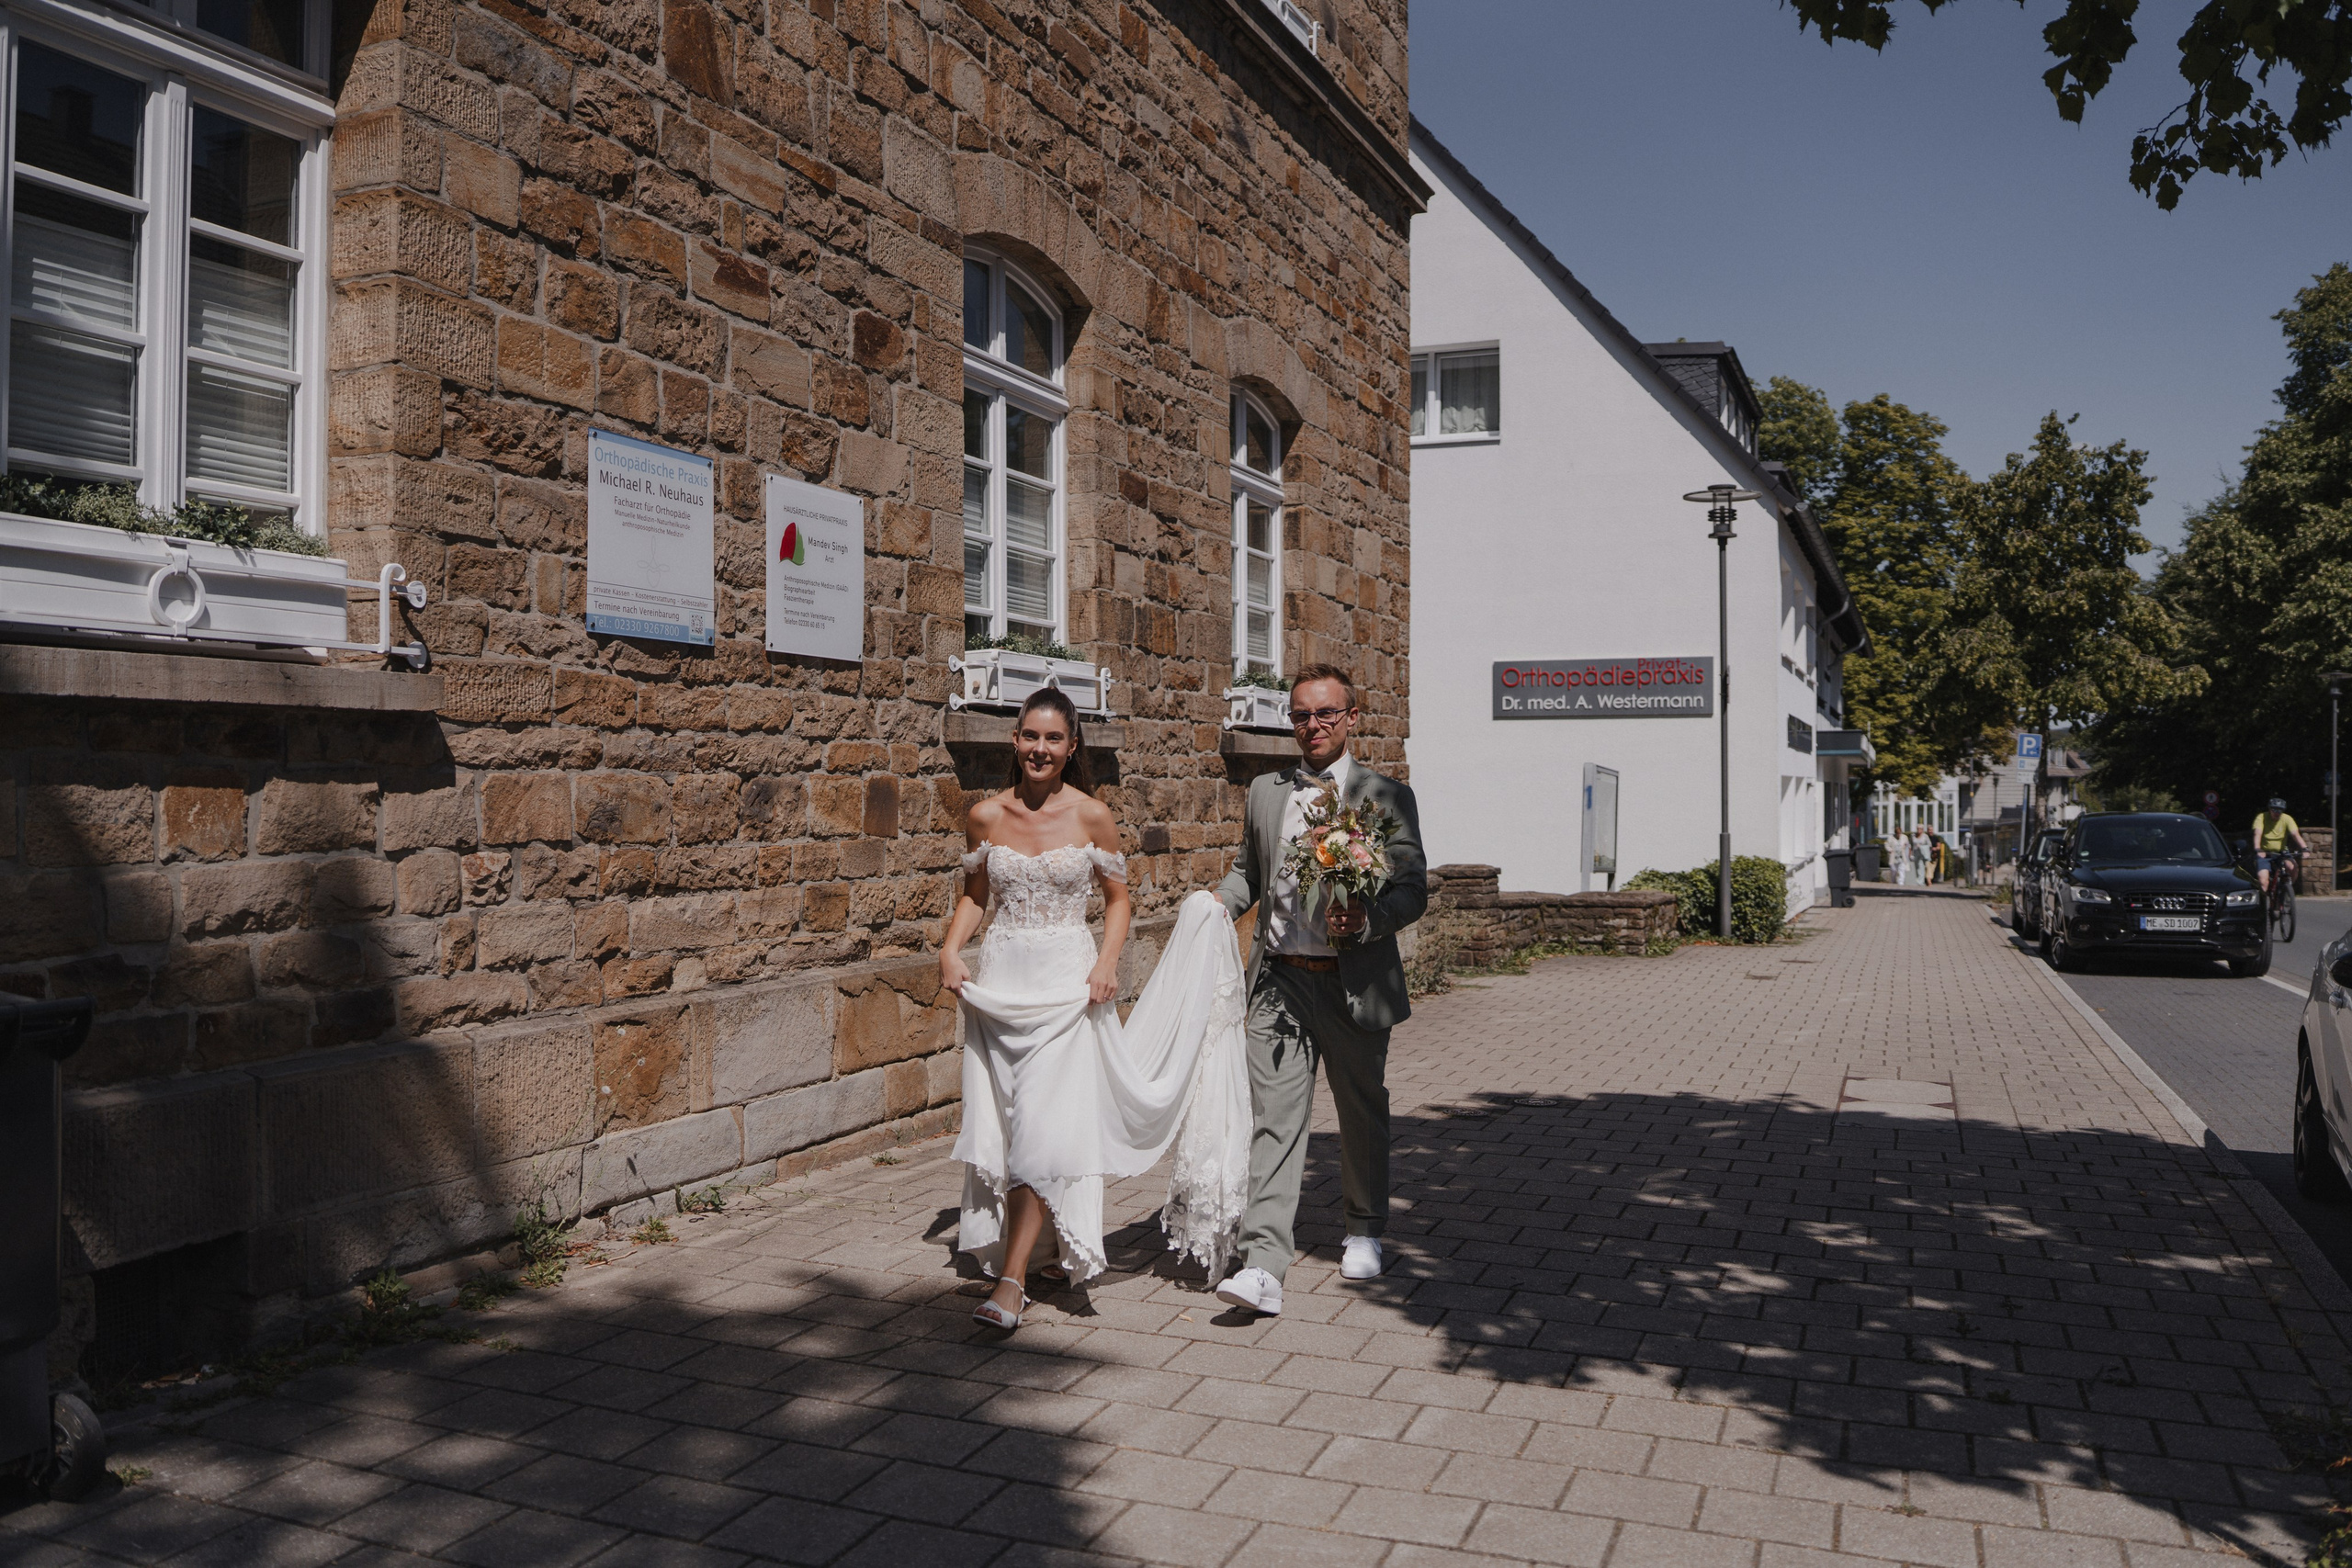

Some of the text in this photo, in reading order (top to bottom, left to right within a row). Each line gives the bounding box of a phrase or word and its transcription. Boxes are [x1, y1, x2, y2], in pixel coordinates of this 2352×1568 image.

[594, 447, 708, 488] Orthopädische Praxis
[599, 468, 704, 506] Michael R. Neuhaus
[614, 496, 691, 520] Facharzt für Orthopädie
[614, 509, 637, 520] Manuelle
[784, 504, 848, 527] HAUSÄRZTLICHE PRIVATPRAXIS
[622, 521, 684, 538] anthroposophische Medizin
[808, 536, 849, 555] Mandev Singh
[825, 555, 834, 563] Arzt
[593, 586, 612, 595] private
[612, 589, 630, 597] Kassen
[635, 592, 676, 605] Kostenerstattung
[681, 598, 708, 608] Selbstzahler
[784, 583, 816, 596] Biographiearbeit
[784, 593, 815, 605] Faszientherapie
[594, 600, 680, 622] Termine nach Vereinbarung
[784, 607, 800, 617] Termine
[809, 612, 835, 624] Vereinbarung
[593, 615, 680, 637] Tel.: 02330 9267800
[784, 616, 798, 626] Telefon
[1638, 658, 1687, 670] Privat-
[1501, 663, 1705, 690] Orthopädiepraxis
[1501, 694, 1704, 711] Dr. med. A. Westermann
[2022, 737, 2037, 754] P
[2146, 919, 2199, 928] ME SD 1007
